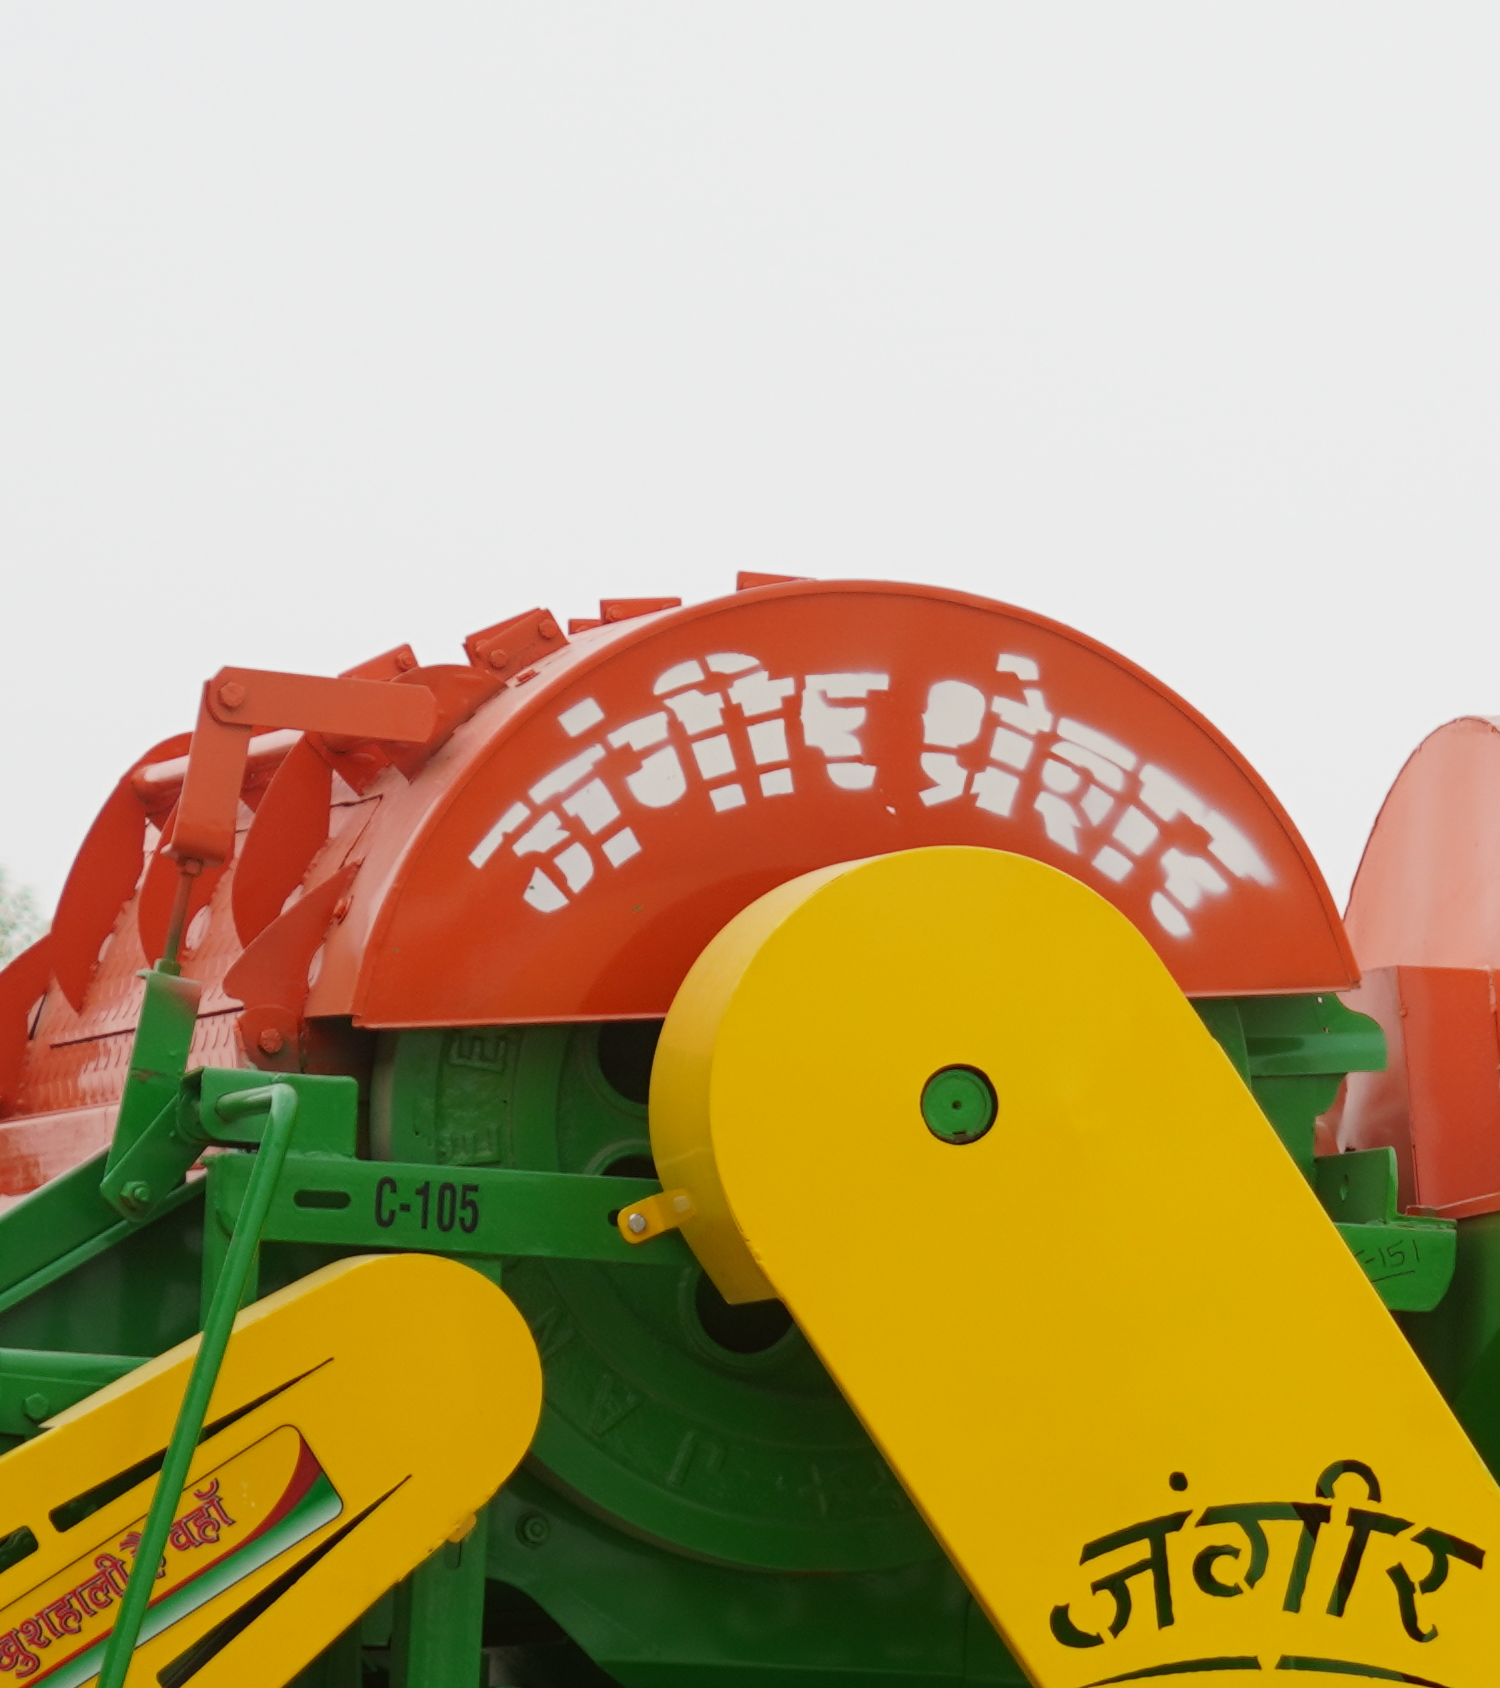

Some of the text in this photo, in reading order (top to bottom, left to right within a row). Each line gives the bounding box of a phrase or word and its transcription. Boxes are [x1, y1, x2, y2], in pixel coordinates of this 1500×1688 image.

[467, 651, 891, 914] जंगीर
[374, 1176, 480, 1234] C-105
[1355, 1238, 1420, 1268] -151
[1049, 1458, 1486, 1649] जंगीर
